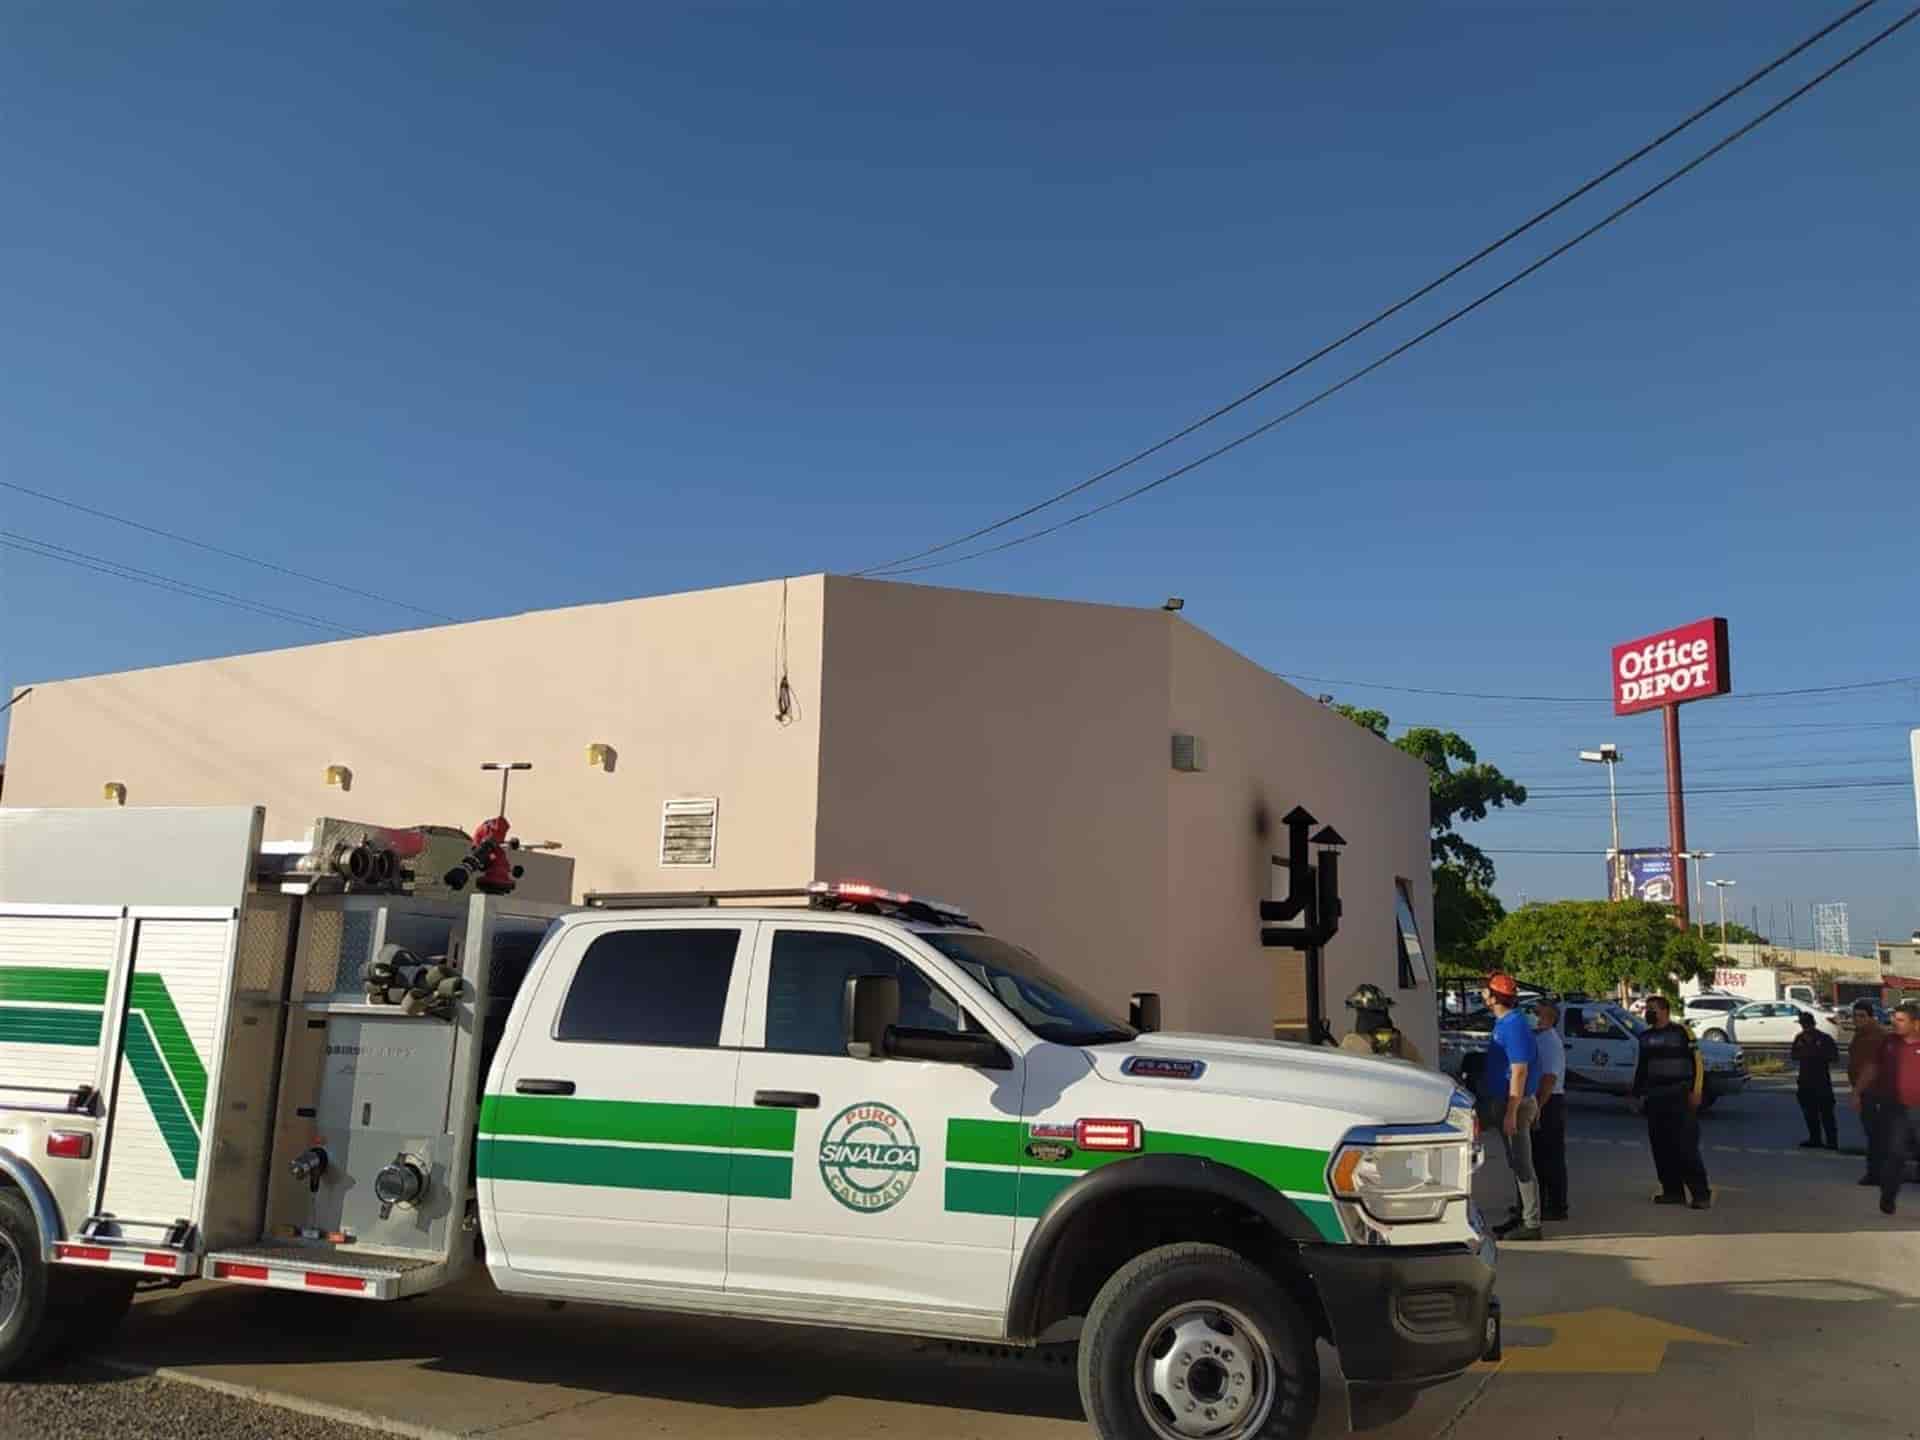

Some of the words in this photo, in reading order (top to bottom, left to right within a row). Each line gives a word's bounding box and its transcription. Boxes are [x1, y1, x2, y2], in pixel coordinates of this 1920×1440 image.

[1619, 638, 1708, 680] Office
[1620, 662, 1709, 704] DEPOT
[845, 1108, 897, 1126] PURO
[820, 1145, 916, 1166] SINALOA
[831, 1174, 904, 1206] CALIDAD
